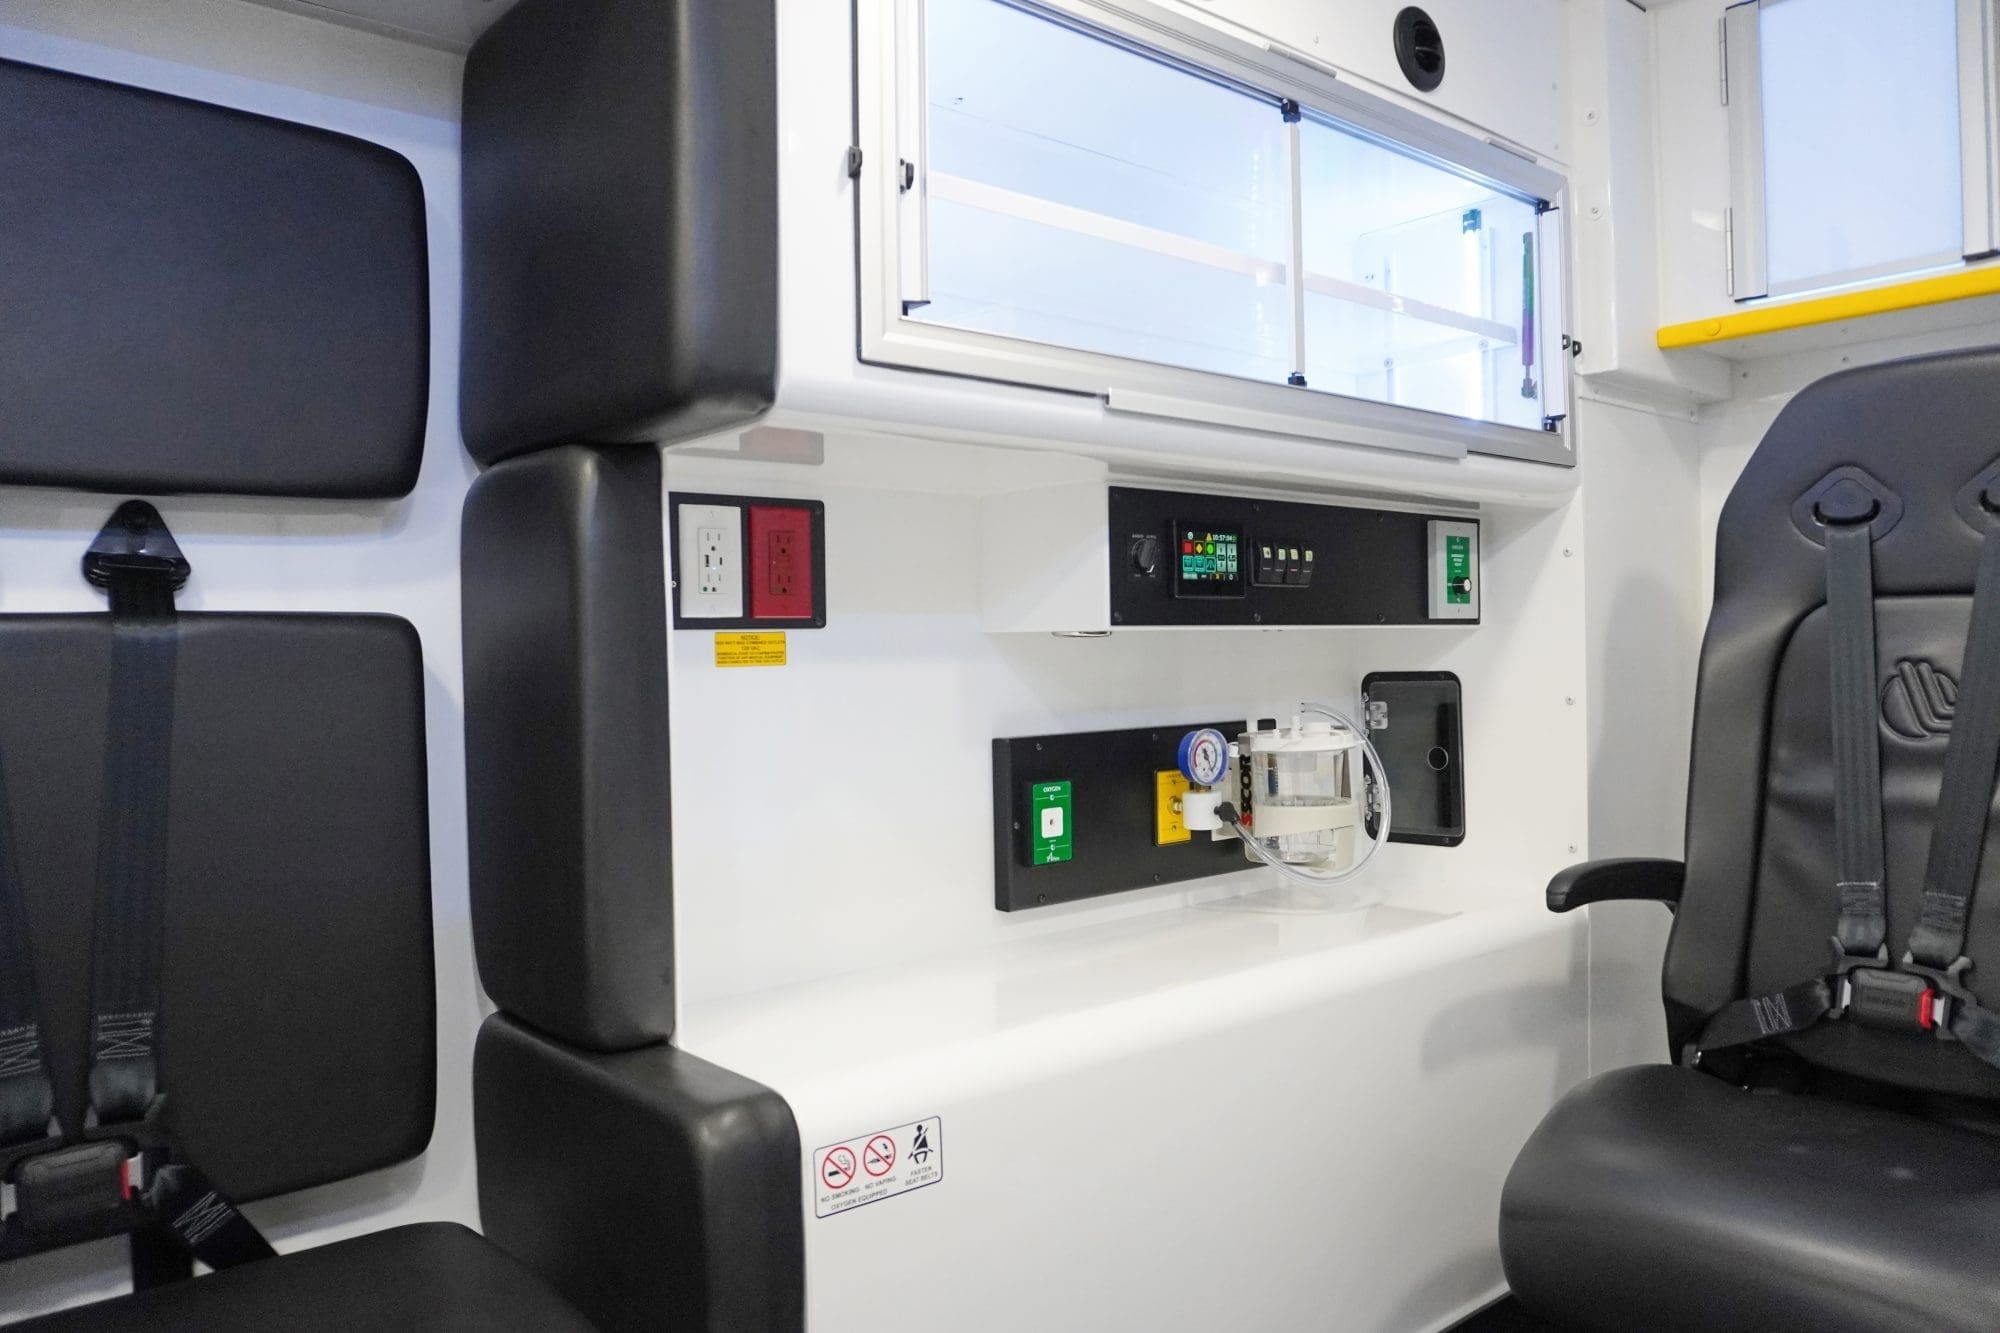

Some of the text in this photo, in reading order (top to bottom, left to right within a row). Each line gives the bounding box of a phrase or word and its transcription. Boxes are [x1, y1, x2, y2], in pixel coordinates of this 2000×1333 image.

[904, 1171, 938, 1186] SEAT BELTS
[910, 1166, 933, 1177] FASTEN
[864, 1176, 897, 1190] NO VAPING
[820, 1186, 860, 1203] NO SMOKING
[830, 1188, 888, 1210] OXYGEN EQUIPPED
